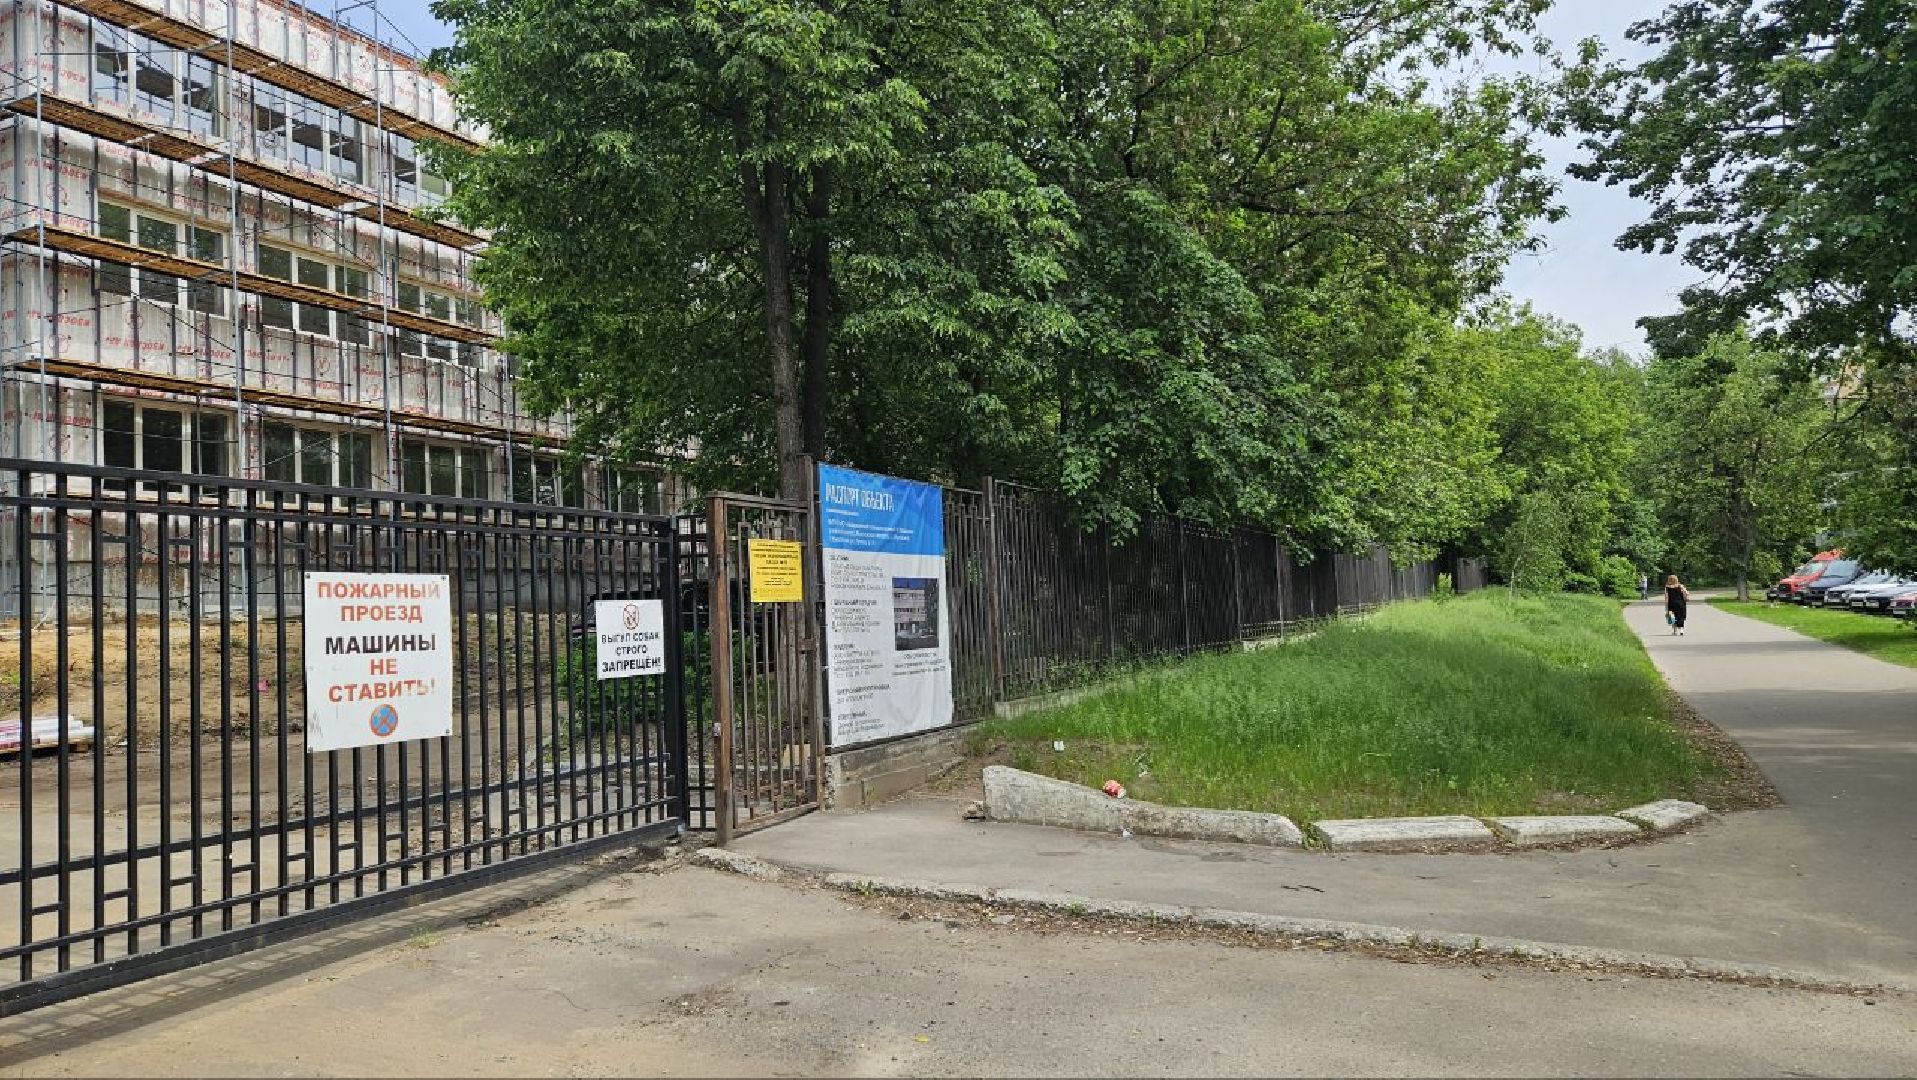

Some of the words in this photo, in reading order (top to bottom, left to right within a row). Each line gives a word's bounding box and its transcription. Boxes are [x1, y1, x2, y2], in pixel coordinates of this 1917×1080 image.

[317, 581, 441, 598] ПОЖАРНЫЙ
[341, 605, 423, 623] ПРОЕЗД
[326, 634, 436, 655] МАШИНЫ
[601, 633, 630, 643] ВЫГУЛ
[633, 632, 659, 641] СОБАК
[616, 645, 647, 656] СТРОГО
[370, 659, 398, 675] НЕ
[328, 678, 436, 702] СТАВИТЬ!
